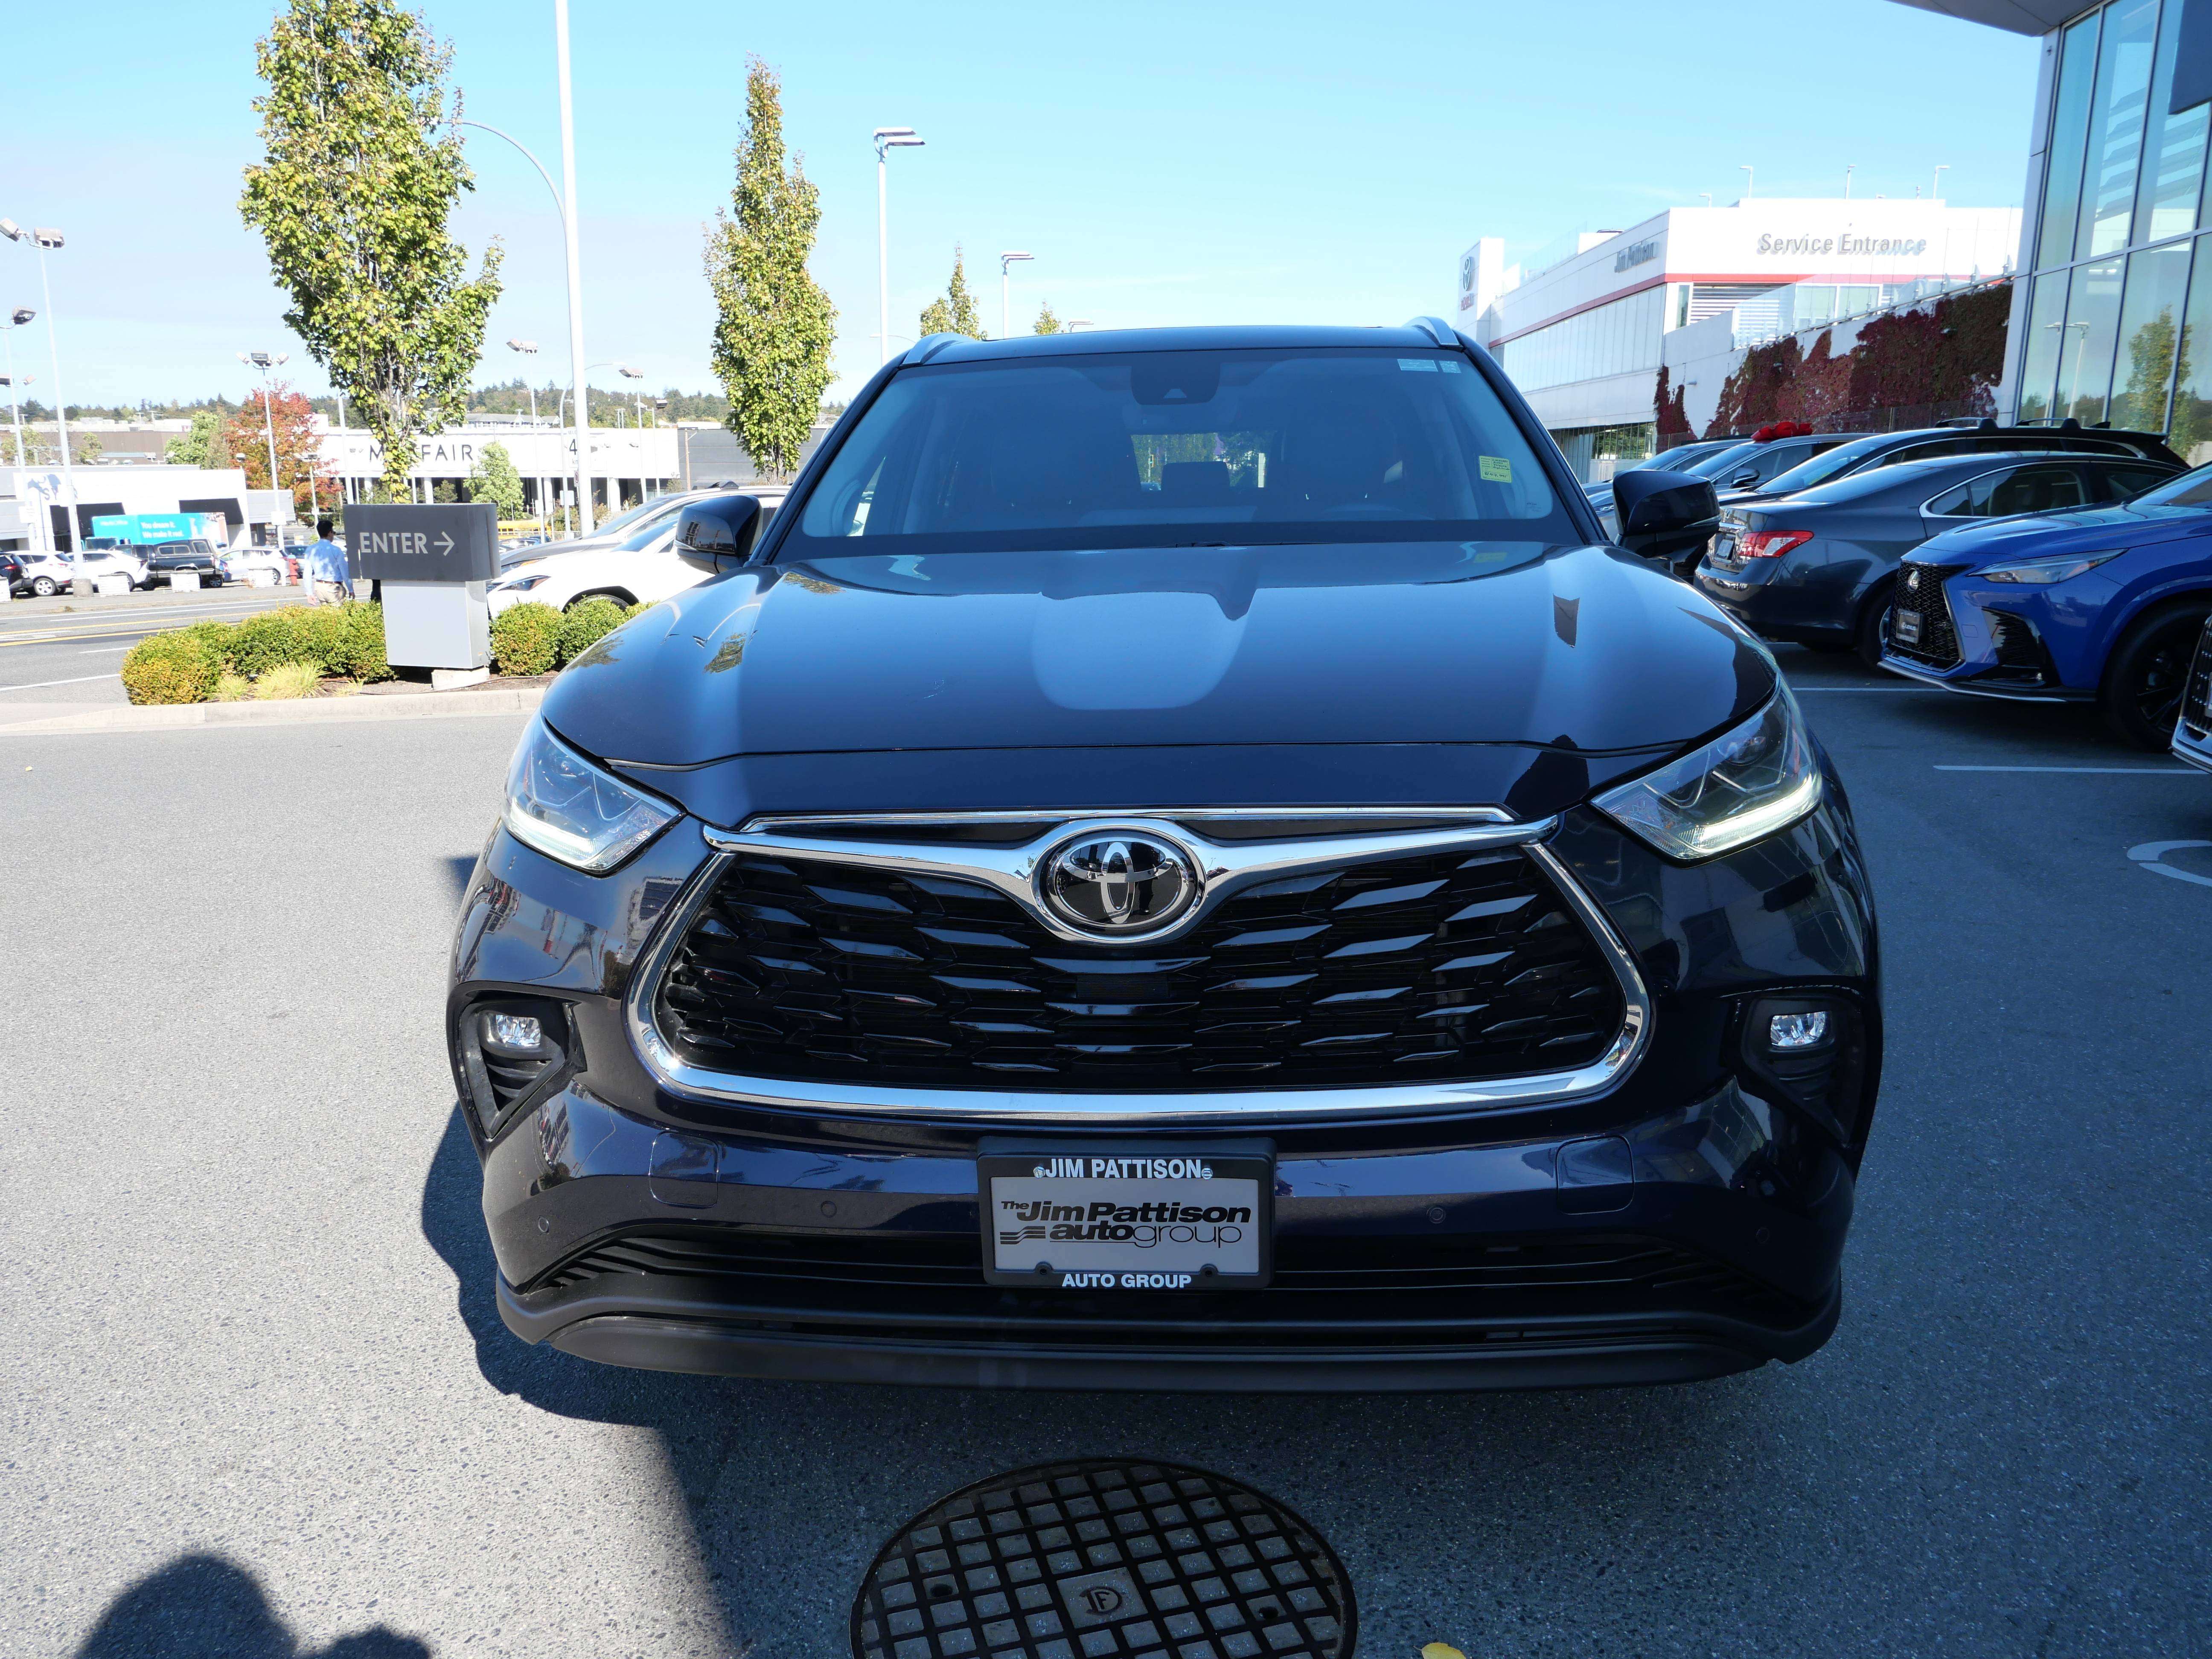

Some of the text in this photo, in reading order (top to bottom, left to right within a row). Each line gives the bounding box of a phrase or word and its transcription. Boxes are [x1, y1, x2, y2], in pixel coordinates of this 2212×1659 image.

[1760, 233, 1927, 252] Service Entrance
[370, 444, 473, 461] MFAIR
[569, 438, 578, 455] 4
[359, 532, 428, 554] ENTER
[1045, 1158, 1202, 1179] JIM PATTISON
[1001, 1201, 1251, 1223] The Jim Pattison
[1062, 1274, 1192, 1289] AUTO GROUP
